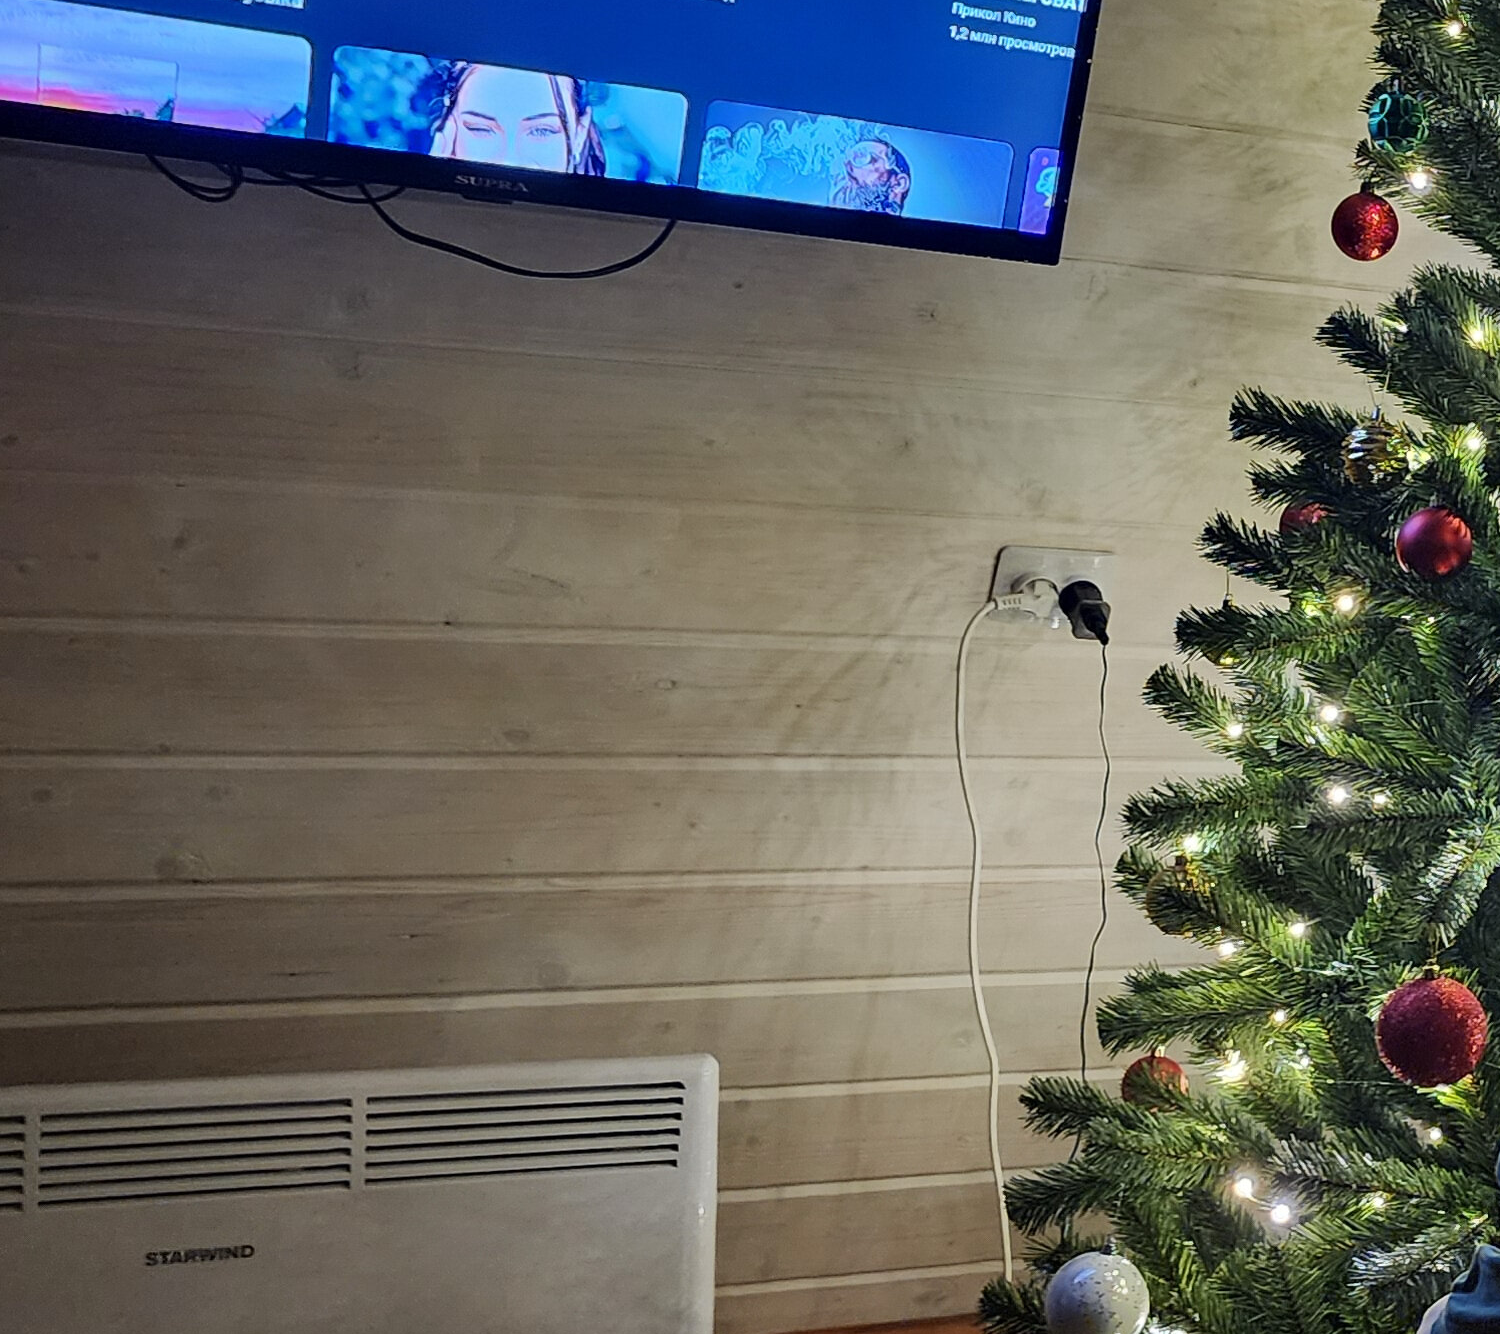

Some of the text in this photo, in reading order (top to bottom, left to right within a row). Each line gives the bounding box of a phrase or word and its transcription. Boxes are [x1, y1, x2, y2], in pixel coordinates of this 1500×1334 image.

[951, 1, 1037, 28] Прикол Кино
[949, 24, 1076, 60] 1,2 млн просмотров
[454, 174, 529, 193] SUPRA
[145, 1244, 256, 1267] STARWIND
